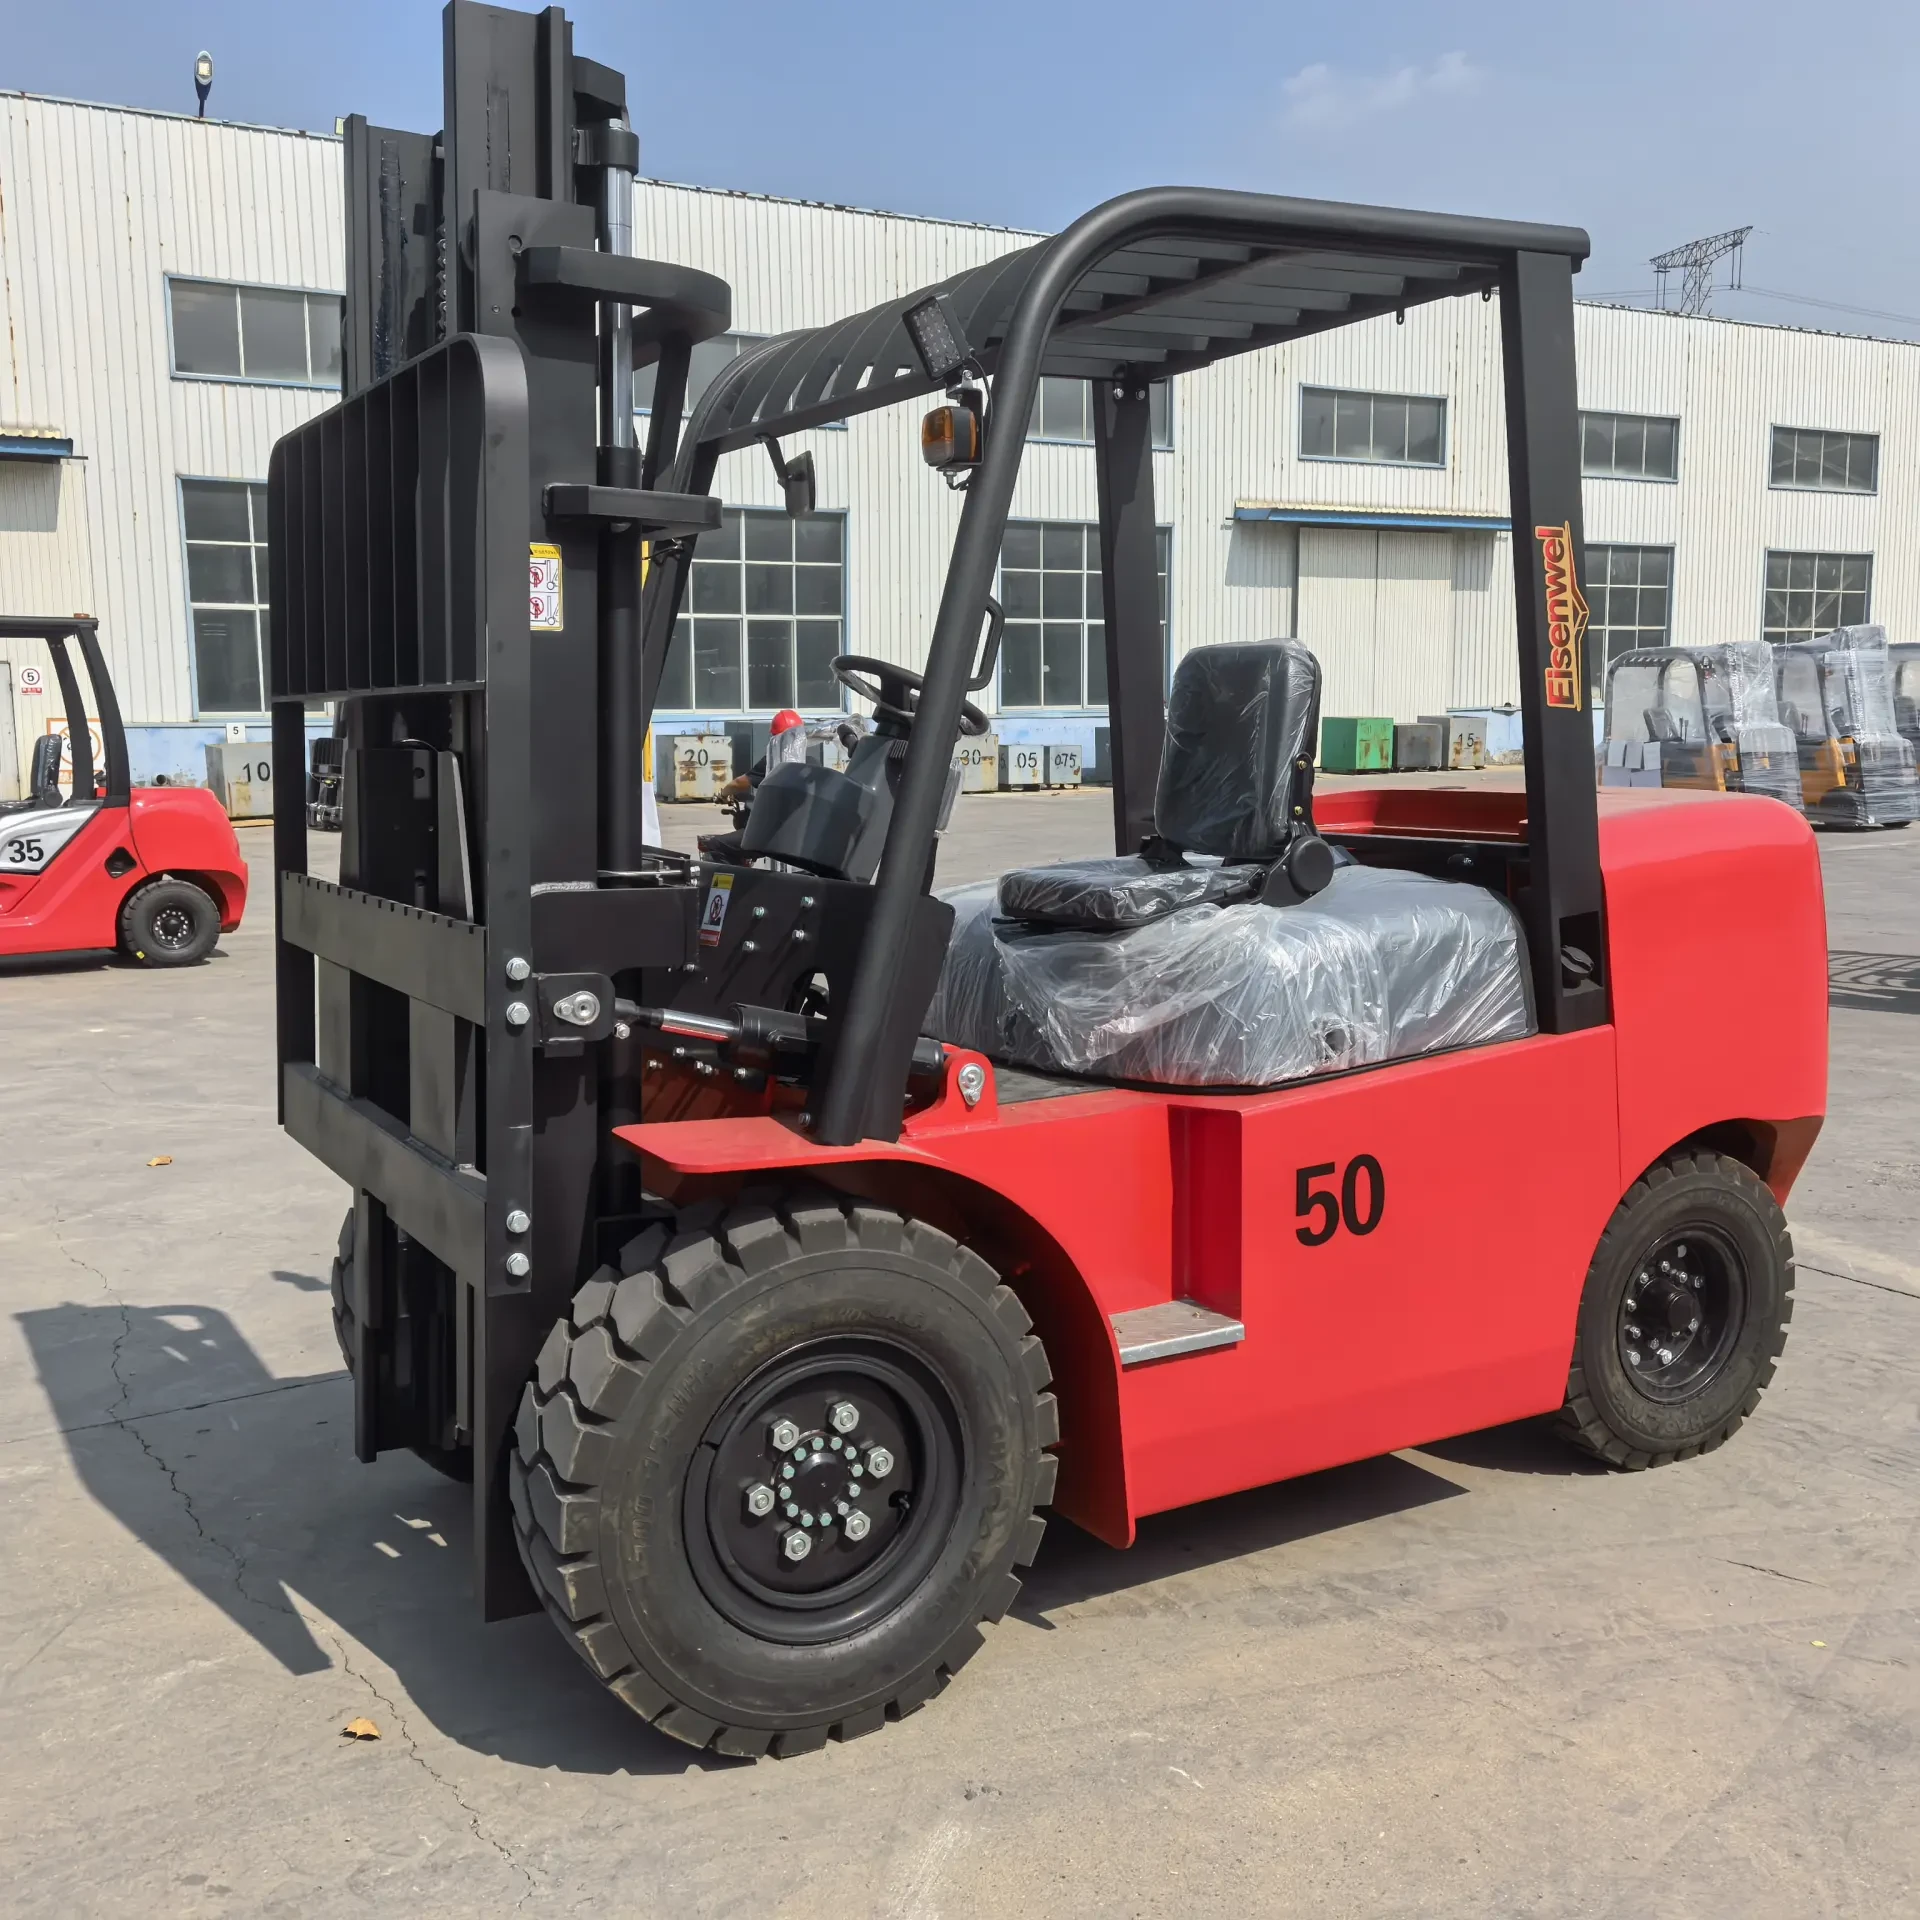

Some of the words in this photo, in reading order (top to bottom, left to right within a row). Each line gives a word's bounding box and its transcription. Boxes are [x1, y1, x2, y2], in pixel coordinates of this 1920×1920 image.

[1536, 527, 1575, 706] Eisenwel
[27, 671, 35, 682] 5
[233, 726, 239, 735] 5
[1458, 732, 1475, 747] 15
[684, 748, 709, 766] 20
[961, 749, 981, 765] 30
[242, 761, 271, 783] 10
[8, 838, 44, 863] 35
[1295, 1153, 1385, 1247] 50
